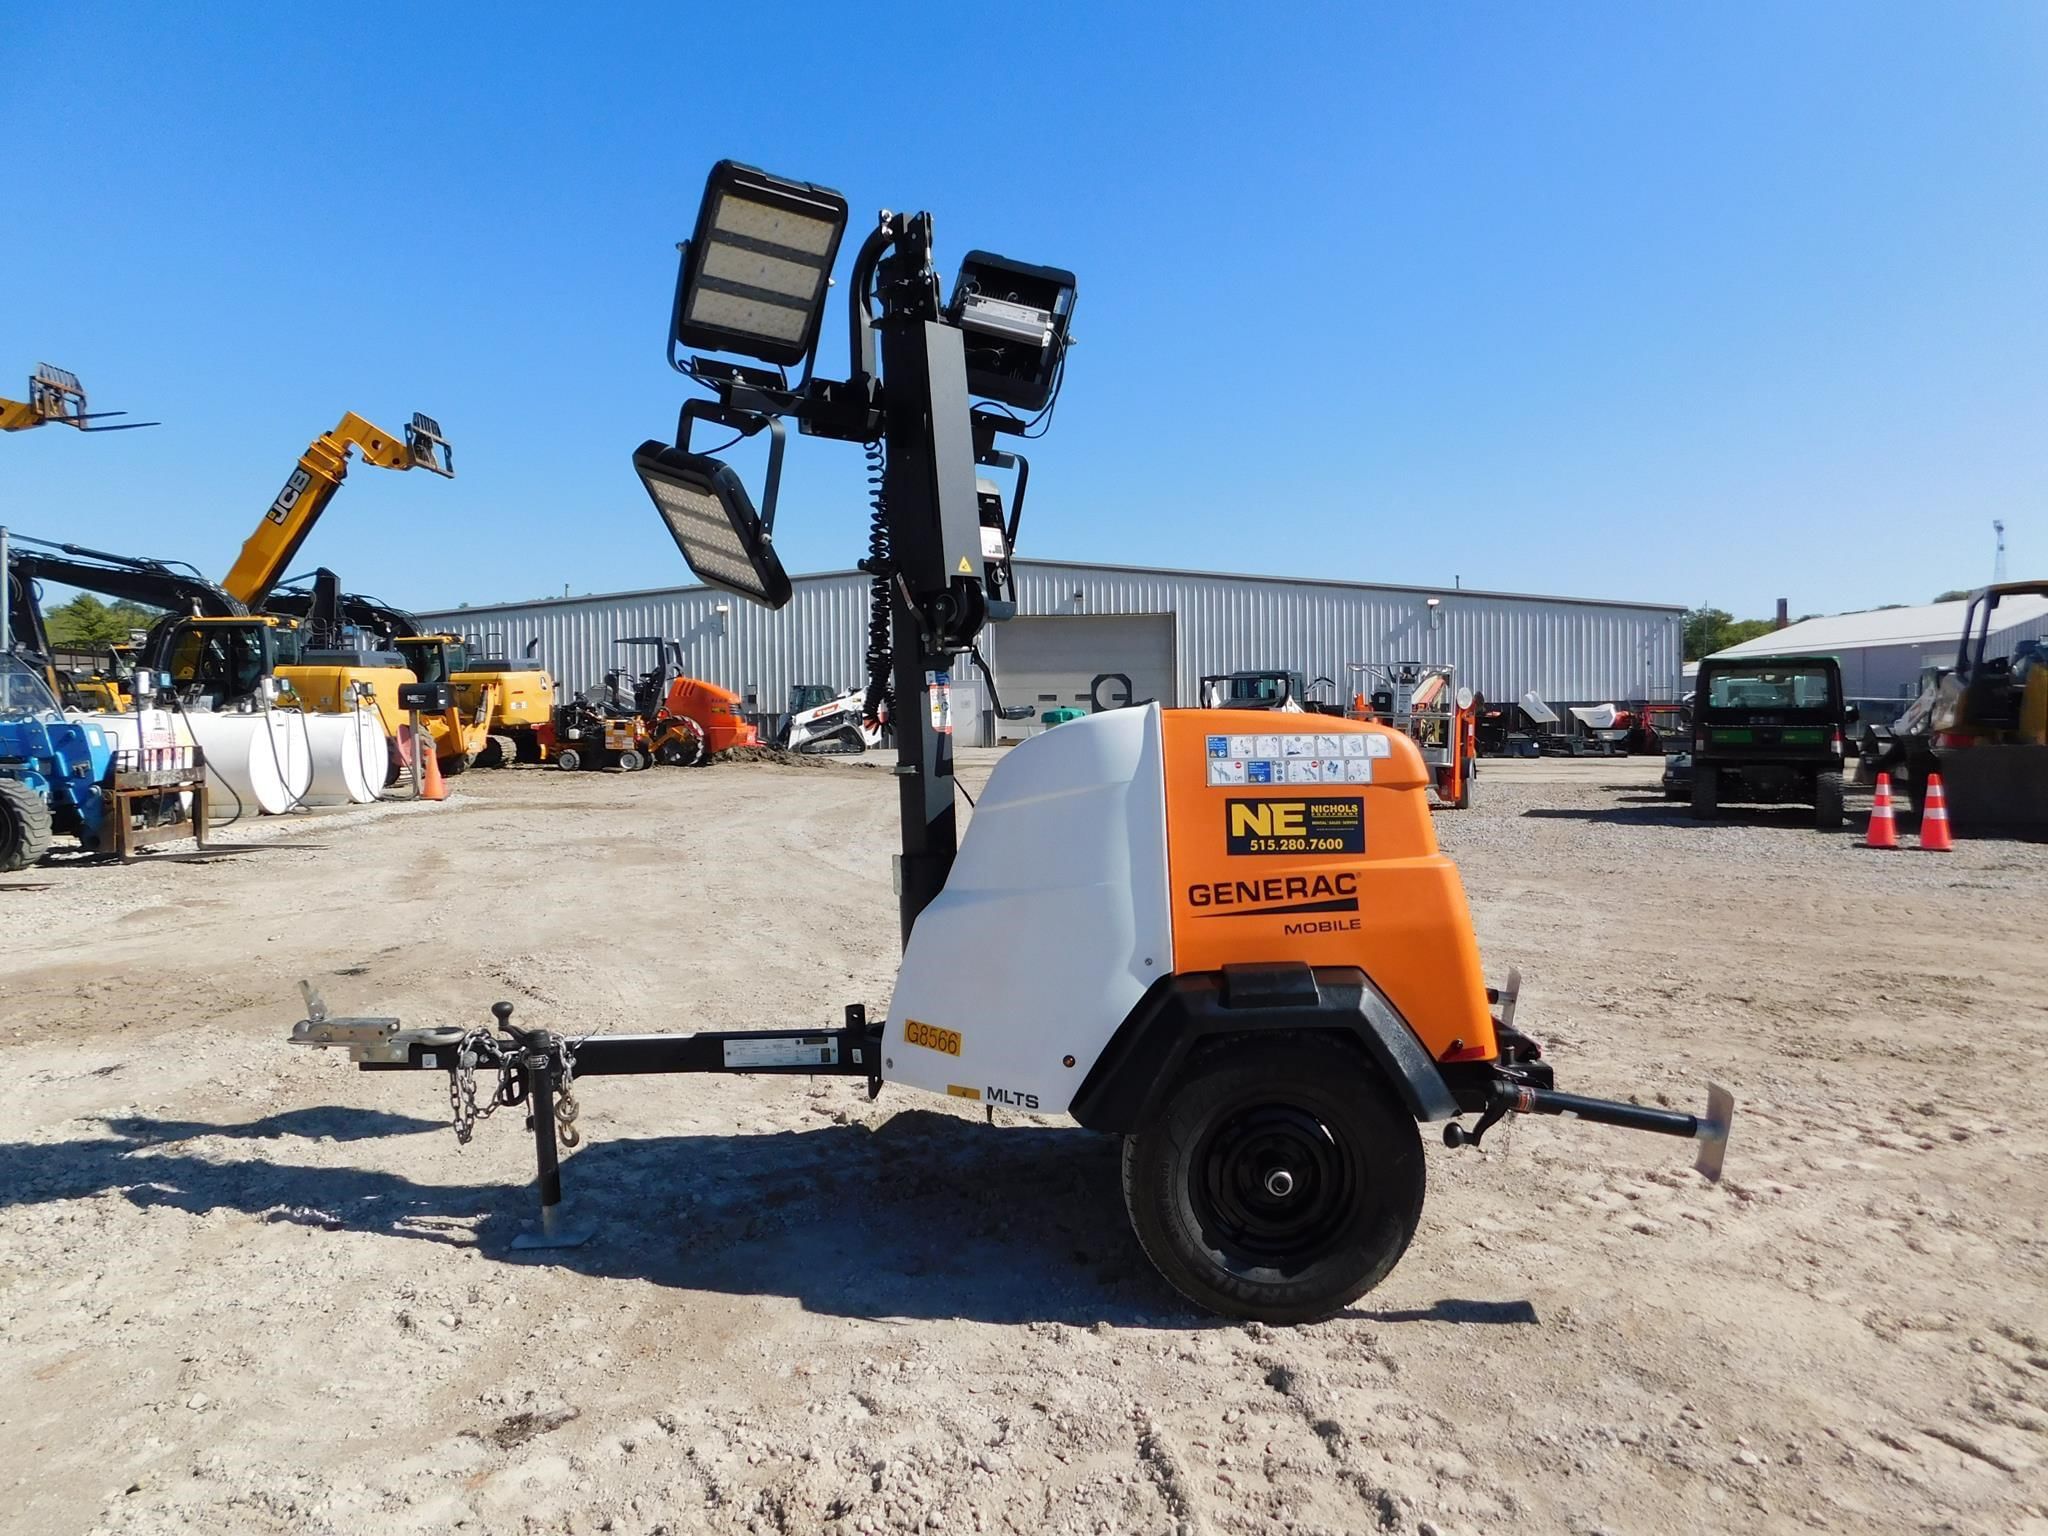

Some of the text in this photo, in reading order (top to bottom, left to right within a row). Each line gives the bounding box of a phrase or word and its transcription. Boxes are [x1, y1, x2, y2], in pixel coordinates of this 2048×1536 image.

[273, 470, 311, 524] JCB
[1231, 803, 1306, 837] NE
[1311, 804, 1358, 813] NICHOLS
[1250, 838, 1343, 851] 515.280.7600
[1188, 873, 1357, 906] GENERAC
[1284, 918, 1361, 935] MOBILE
[907, 1022, 957, 1054] G8566
[987, 1086, 1039, 1109] MLTS
